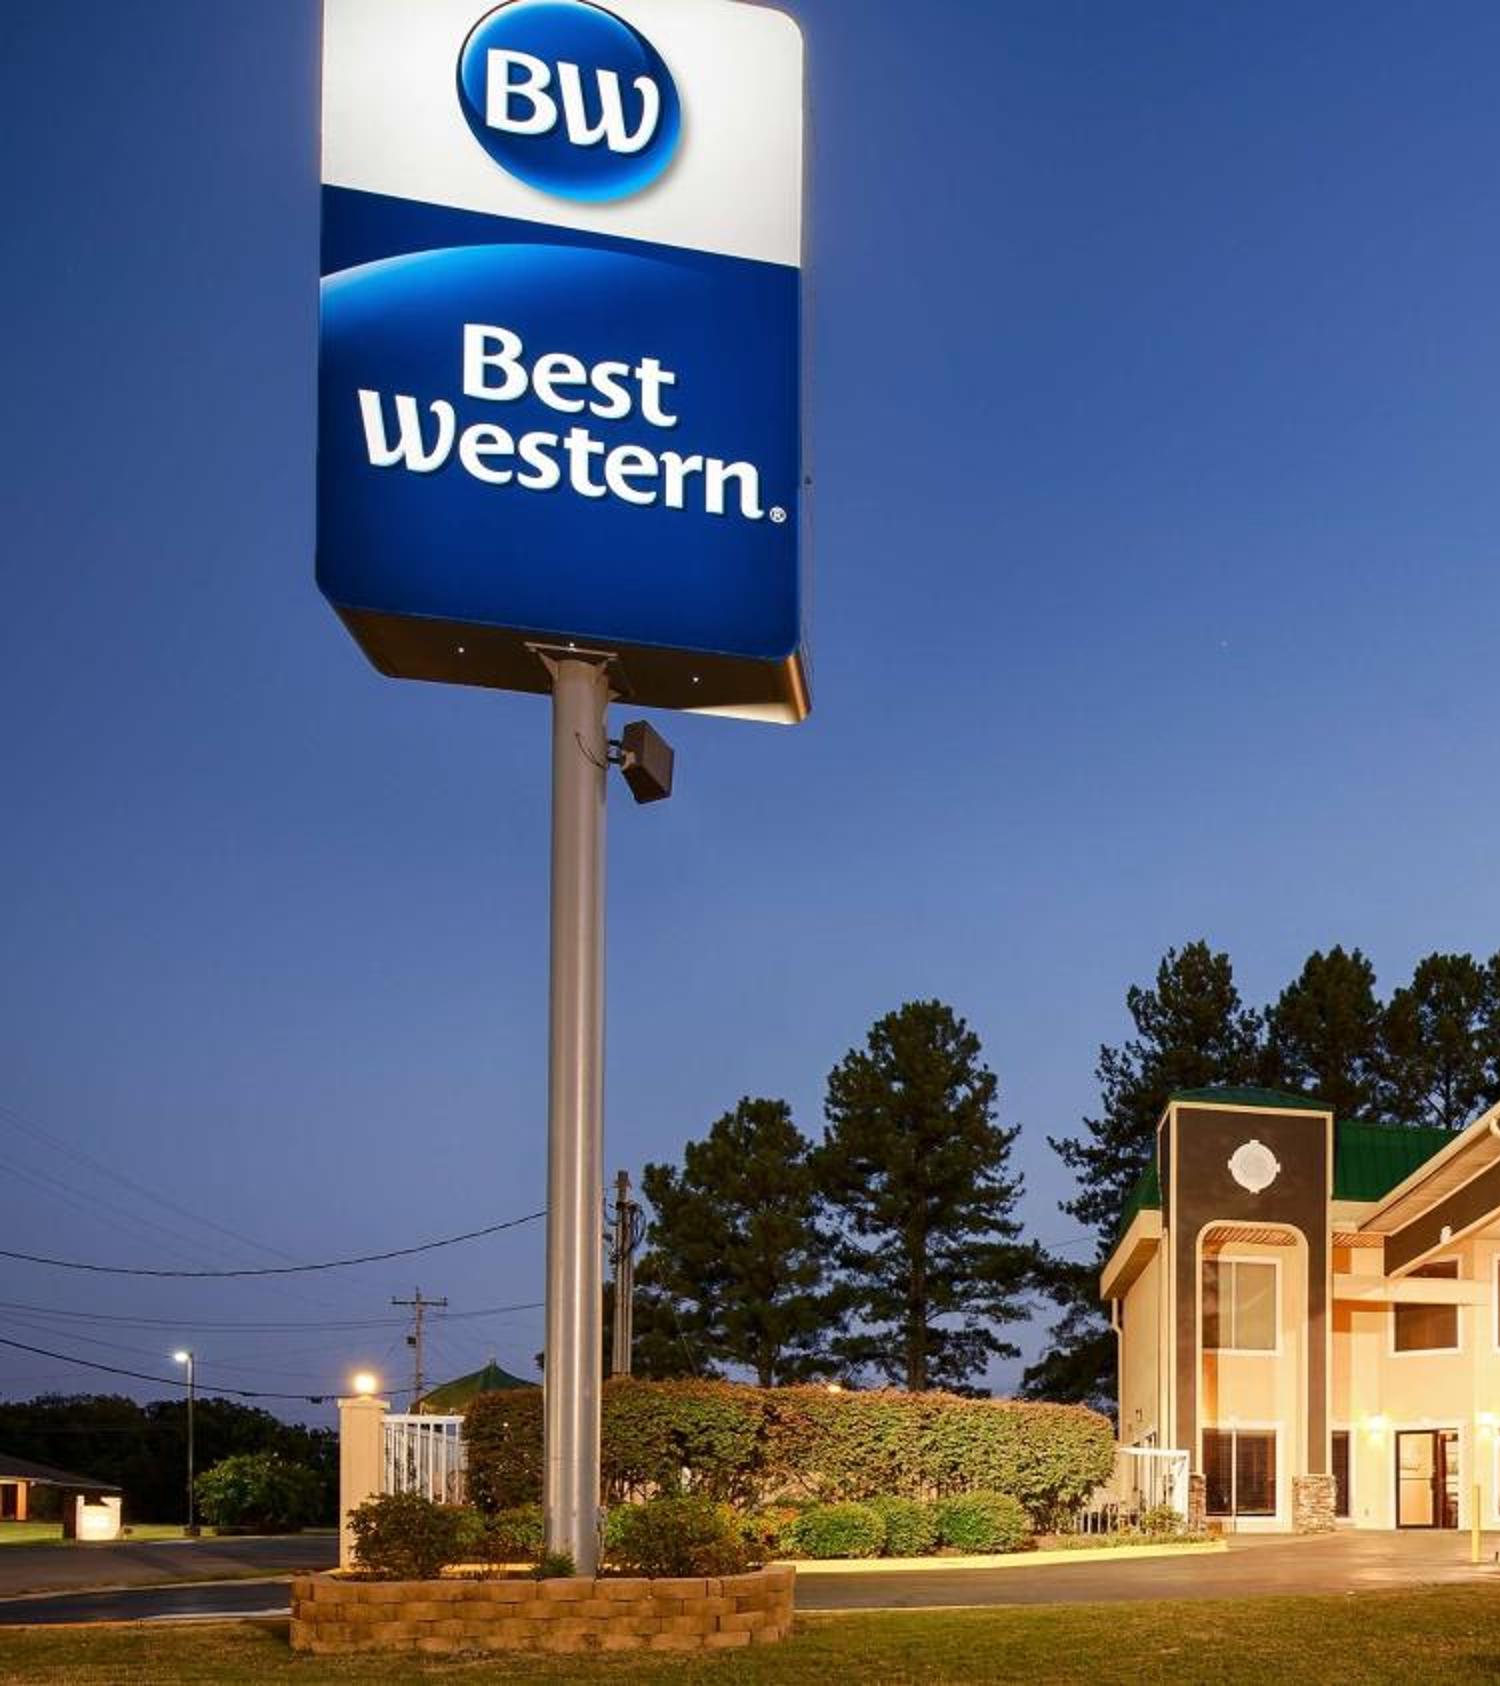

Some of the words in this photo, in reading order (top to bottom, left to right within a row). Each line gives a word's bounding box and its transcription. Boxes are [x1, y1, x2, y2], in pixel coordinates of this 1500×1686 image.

[486, 48, 660, 153] BW
[463, 323, 677, 427] Best
[358, 389, 764, 519] Western
